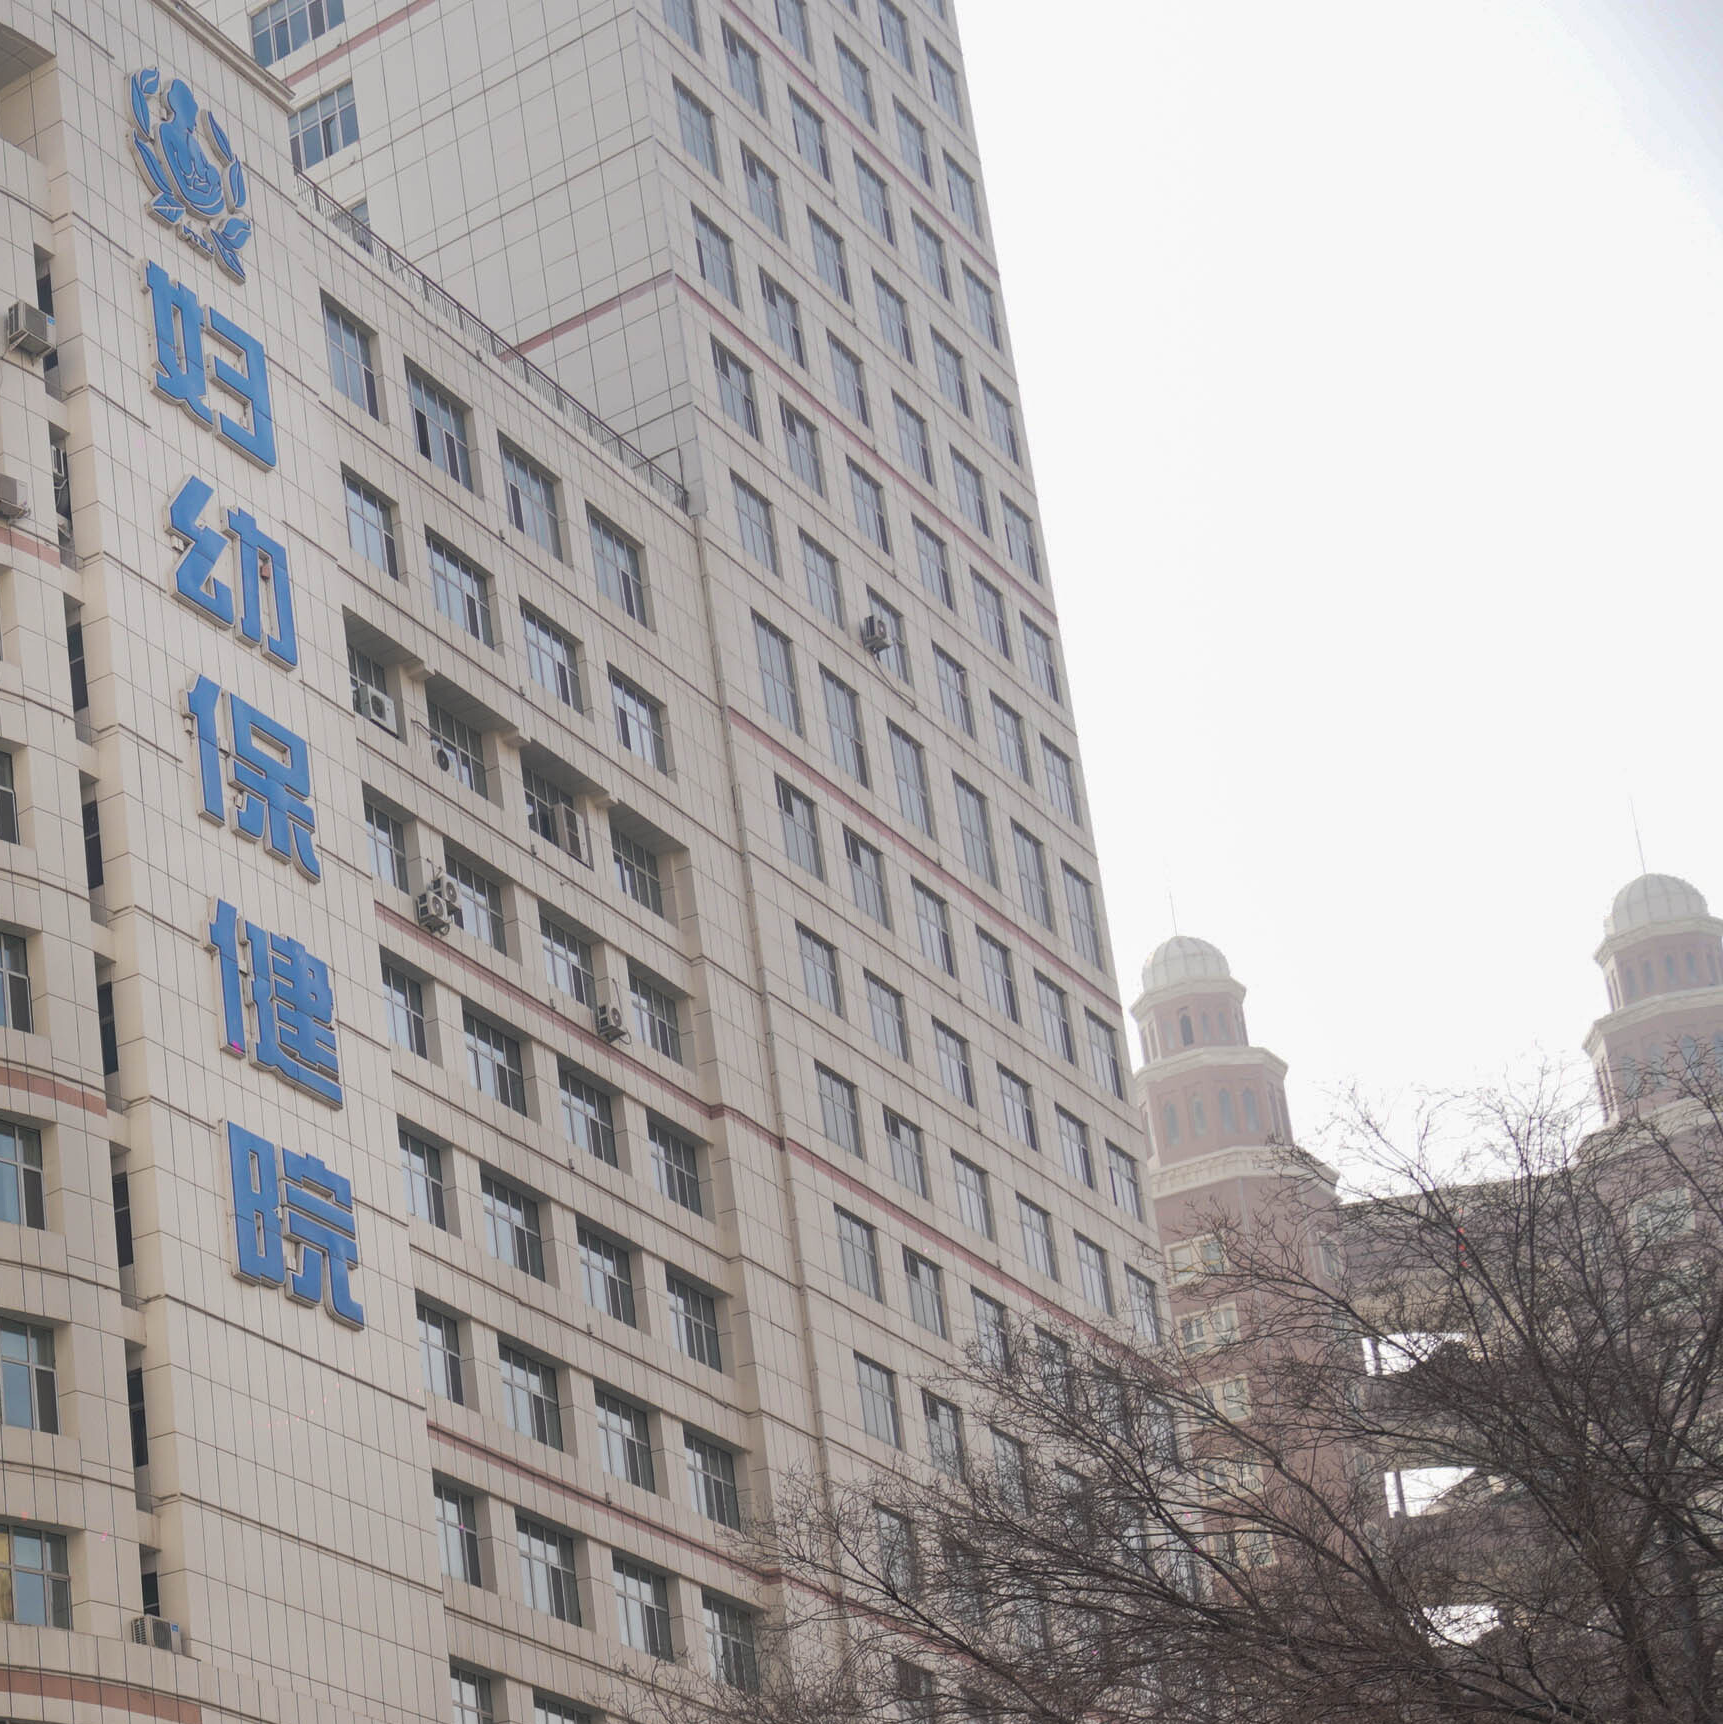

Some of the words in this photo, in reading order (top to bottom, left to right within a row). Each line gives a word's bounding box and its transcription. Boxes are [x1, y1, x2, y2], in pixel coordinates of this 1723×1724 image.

[139, 257, 364, 1331] 妇幼保健院
